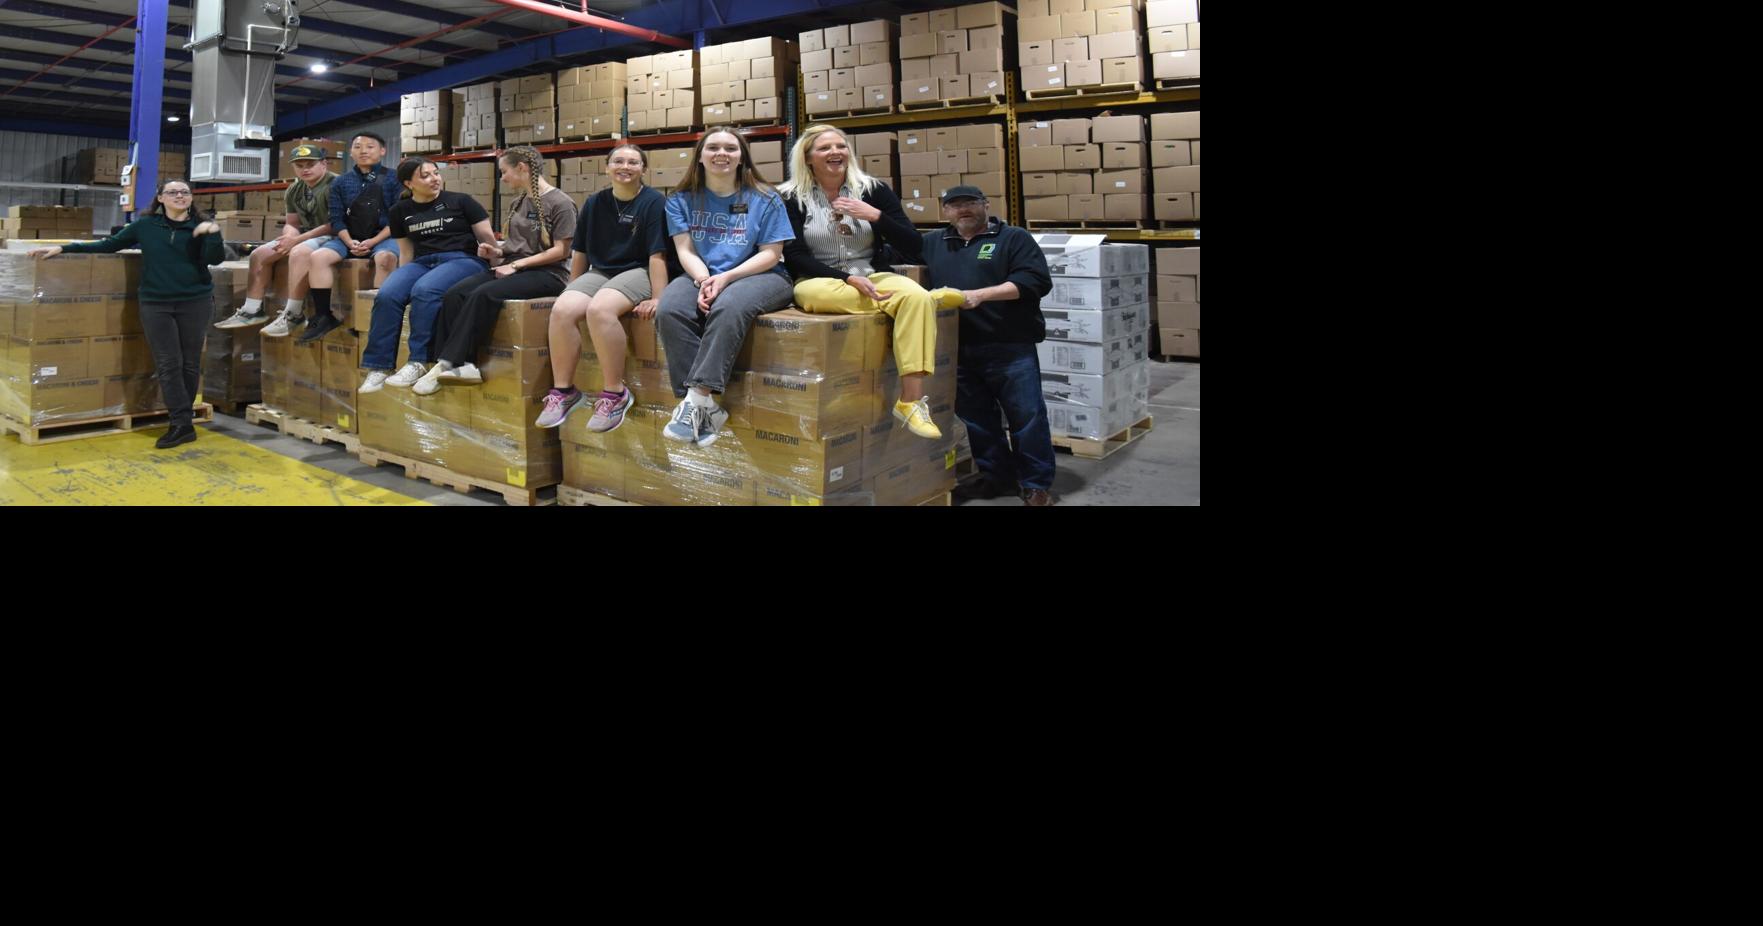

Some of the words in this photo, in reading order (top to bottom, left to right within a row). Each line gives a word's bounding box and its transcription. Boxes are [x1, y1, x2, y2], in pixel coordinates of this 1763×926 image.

[691, 210, 749, 246] USA
[763, 376, 807, 392] MACARONI
[755, 429, 800, 446] MACARONI
